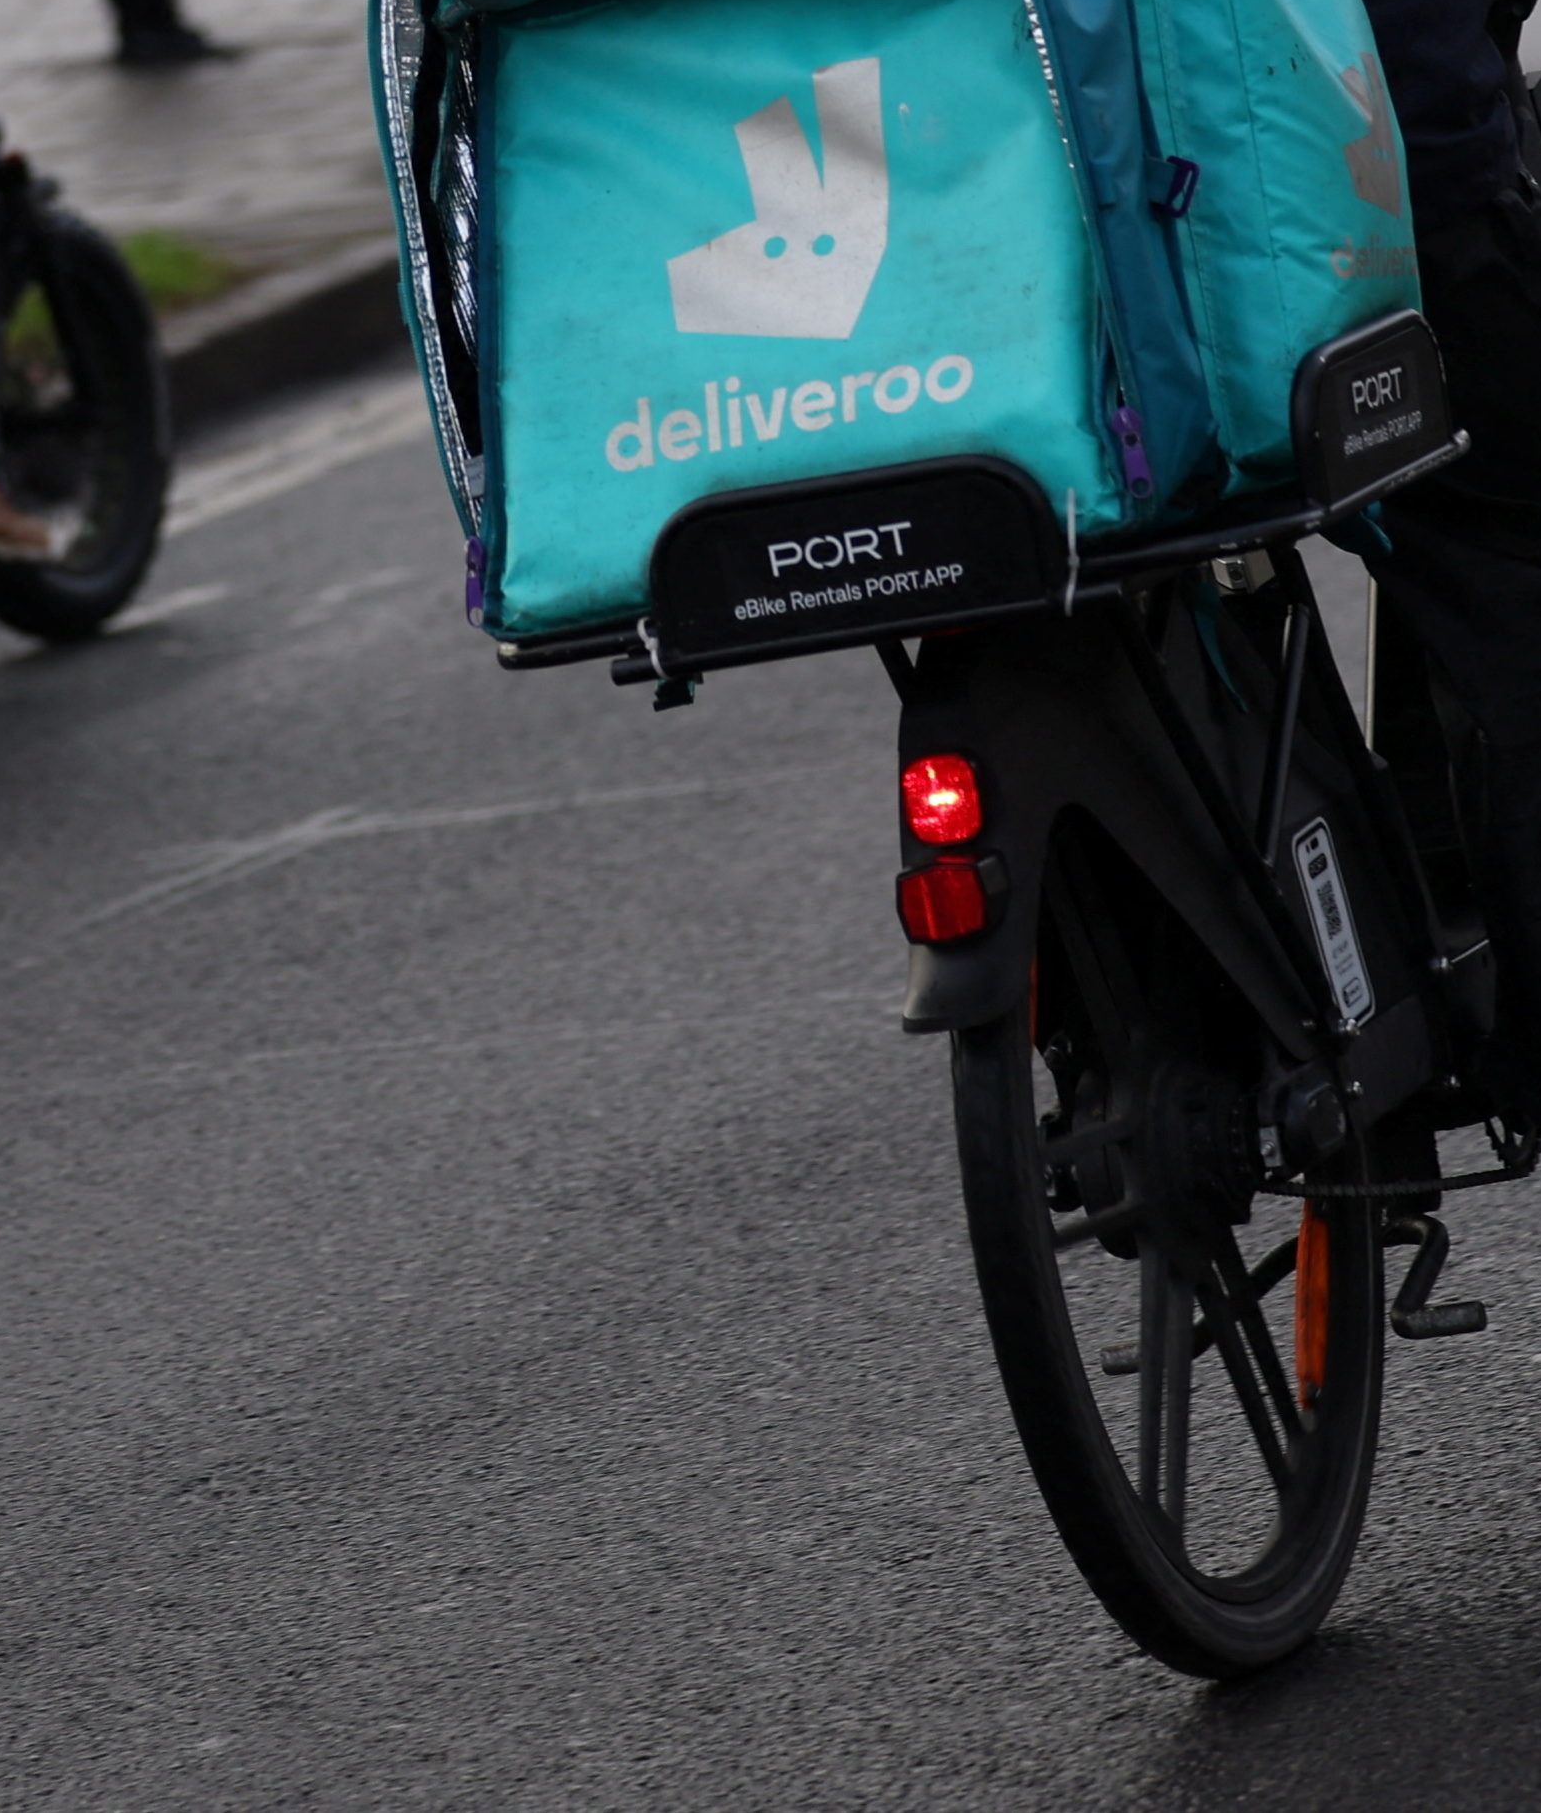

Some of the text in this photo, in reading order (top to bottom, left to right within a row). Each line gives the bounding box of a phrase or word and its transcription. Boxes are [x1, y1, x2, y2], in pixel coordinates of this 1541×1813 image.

[605, 354, 974, 472] deliveroo
[1351, 367, 1402, 415] PORT
[768, 521, 912, 577] PORT
[735, 563, 963, 620] eBike Rentals PORT.APP
